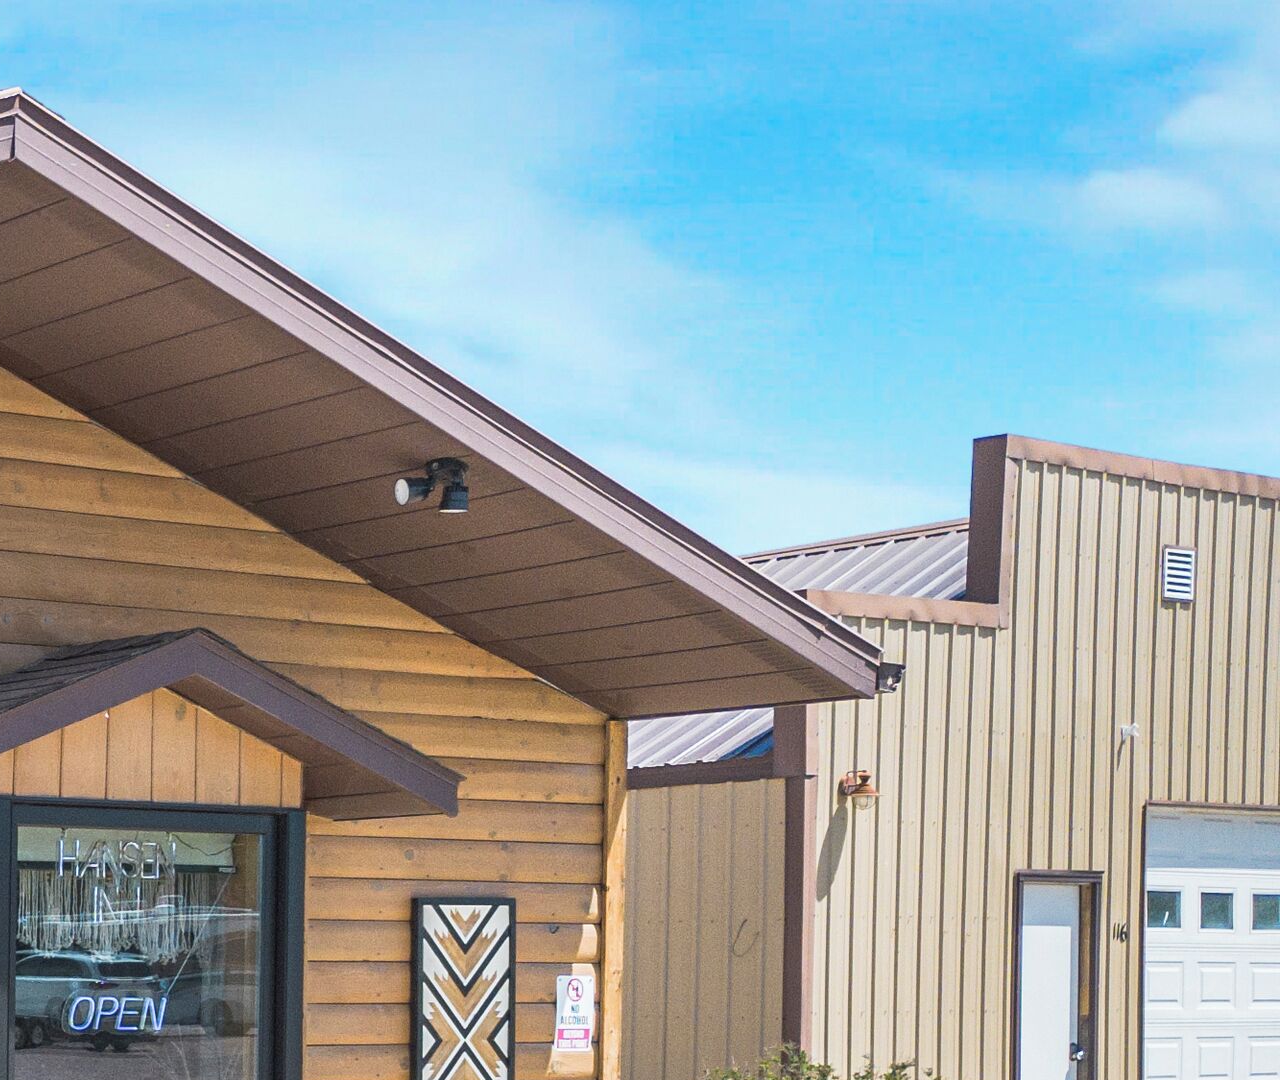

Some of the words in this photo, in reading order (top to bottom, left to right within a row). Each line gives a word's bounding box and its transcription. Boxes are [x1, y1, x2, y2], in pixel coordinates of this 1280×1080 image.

[57, 839, 177, 878] HANSEN
[1112, 921, 1128, 944] 116
[67, 996, 167, 1032] OPEN
